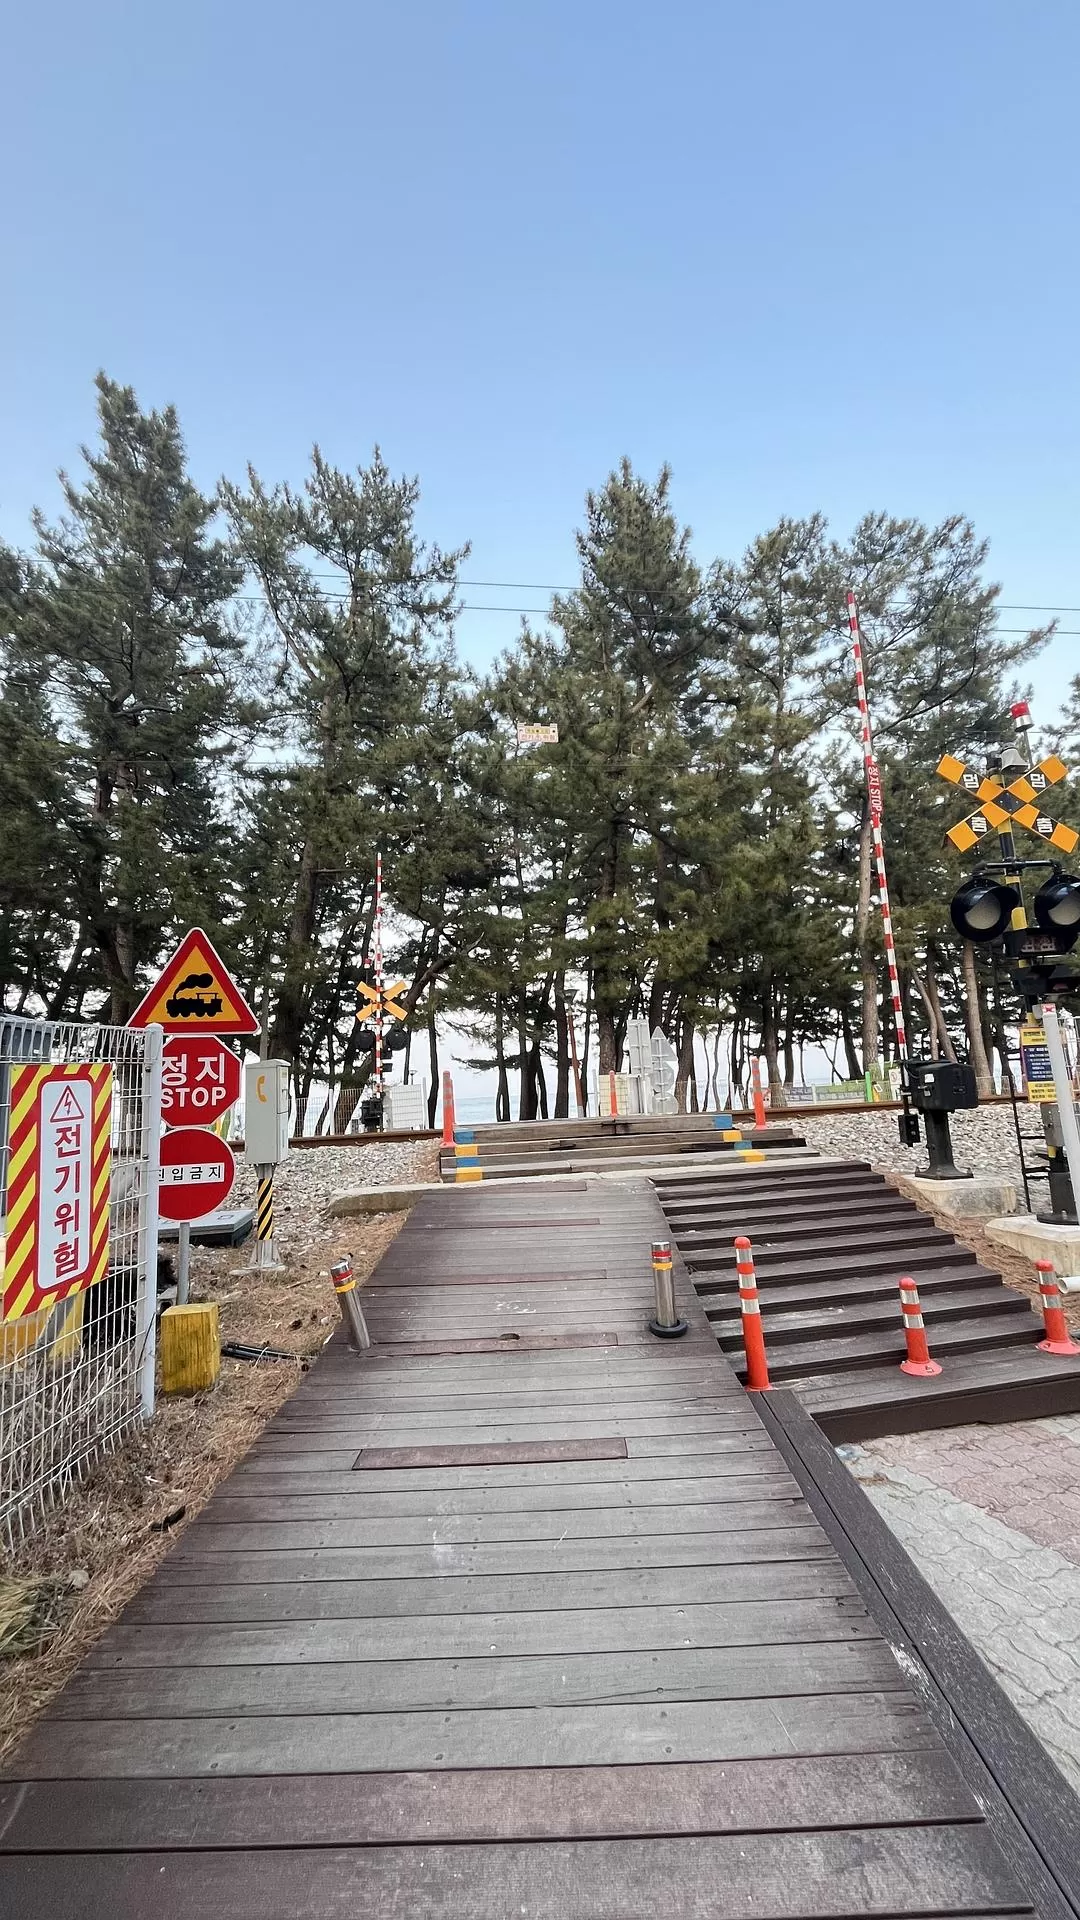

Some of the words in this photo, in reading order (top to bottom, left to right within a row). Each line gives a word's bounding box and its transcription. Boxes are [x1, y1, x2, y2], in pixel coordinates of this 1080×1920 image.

[868, 766, 880, 786] 정지
[963, 773, 979, 789] 멈
[1030, 773, 1046, 788] 멈
[870, 788, 883, 812] STOP
[971, 816, 988, 832] 춤
[1036, 817, 1053, 833] 춤
[162, 1052, 225, 1086] 정지
[161, 1086, 227, 1109] STOP
[53, 1123, 81, 1279] 전기위험
